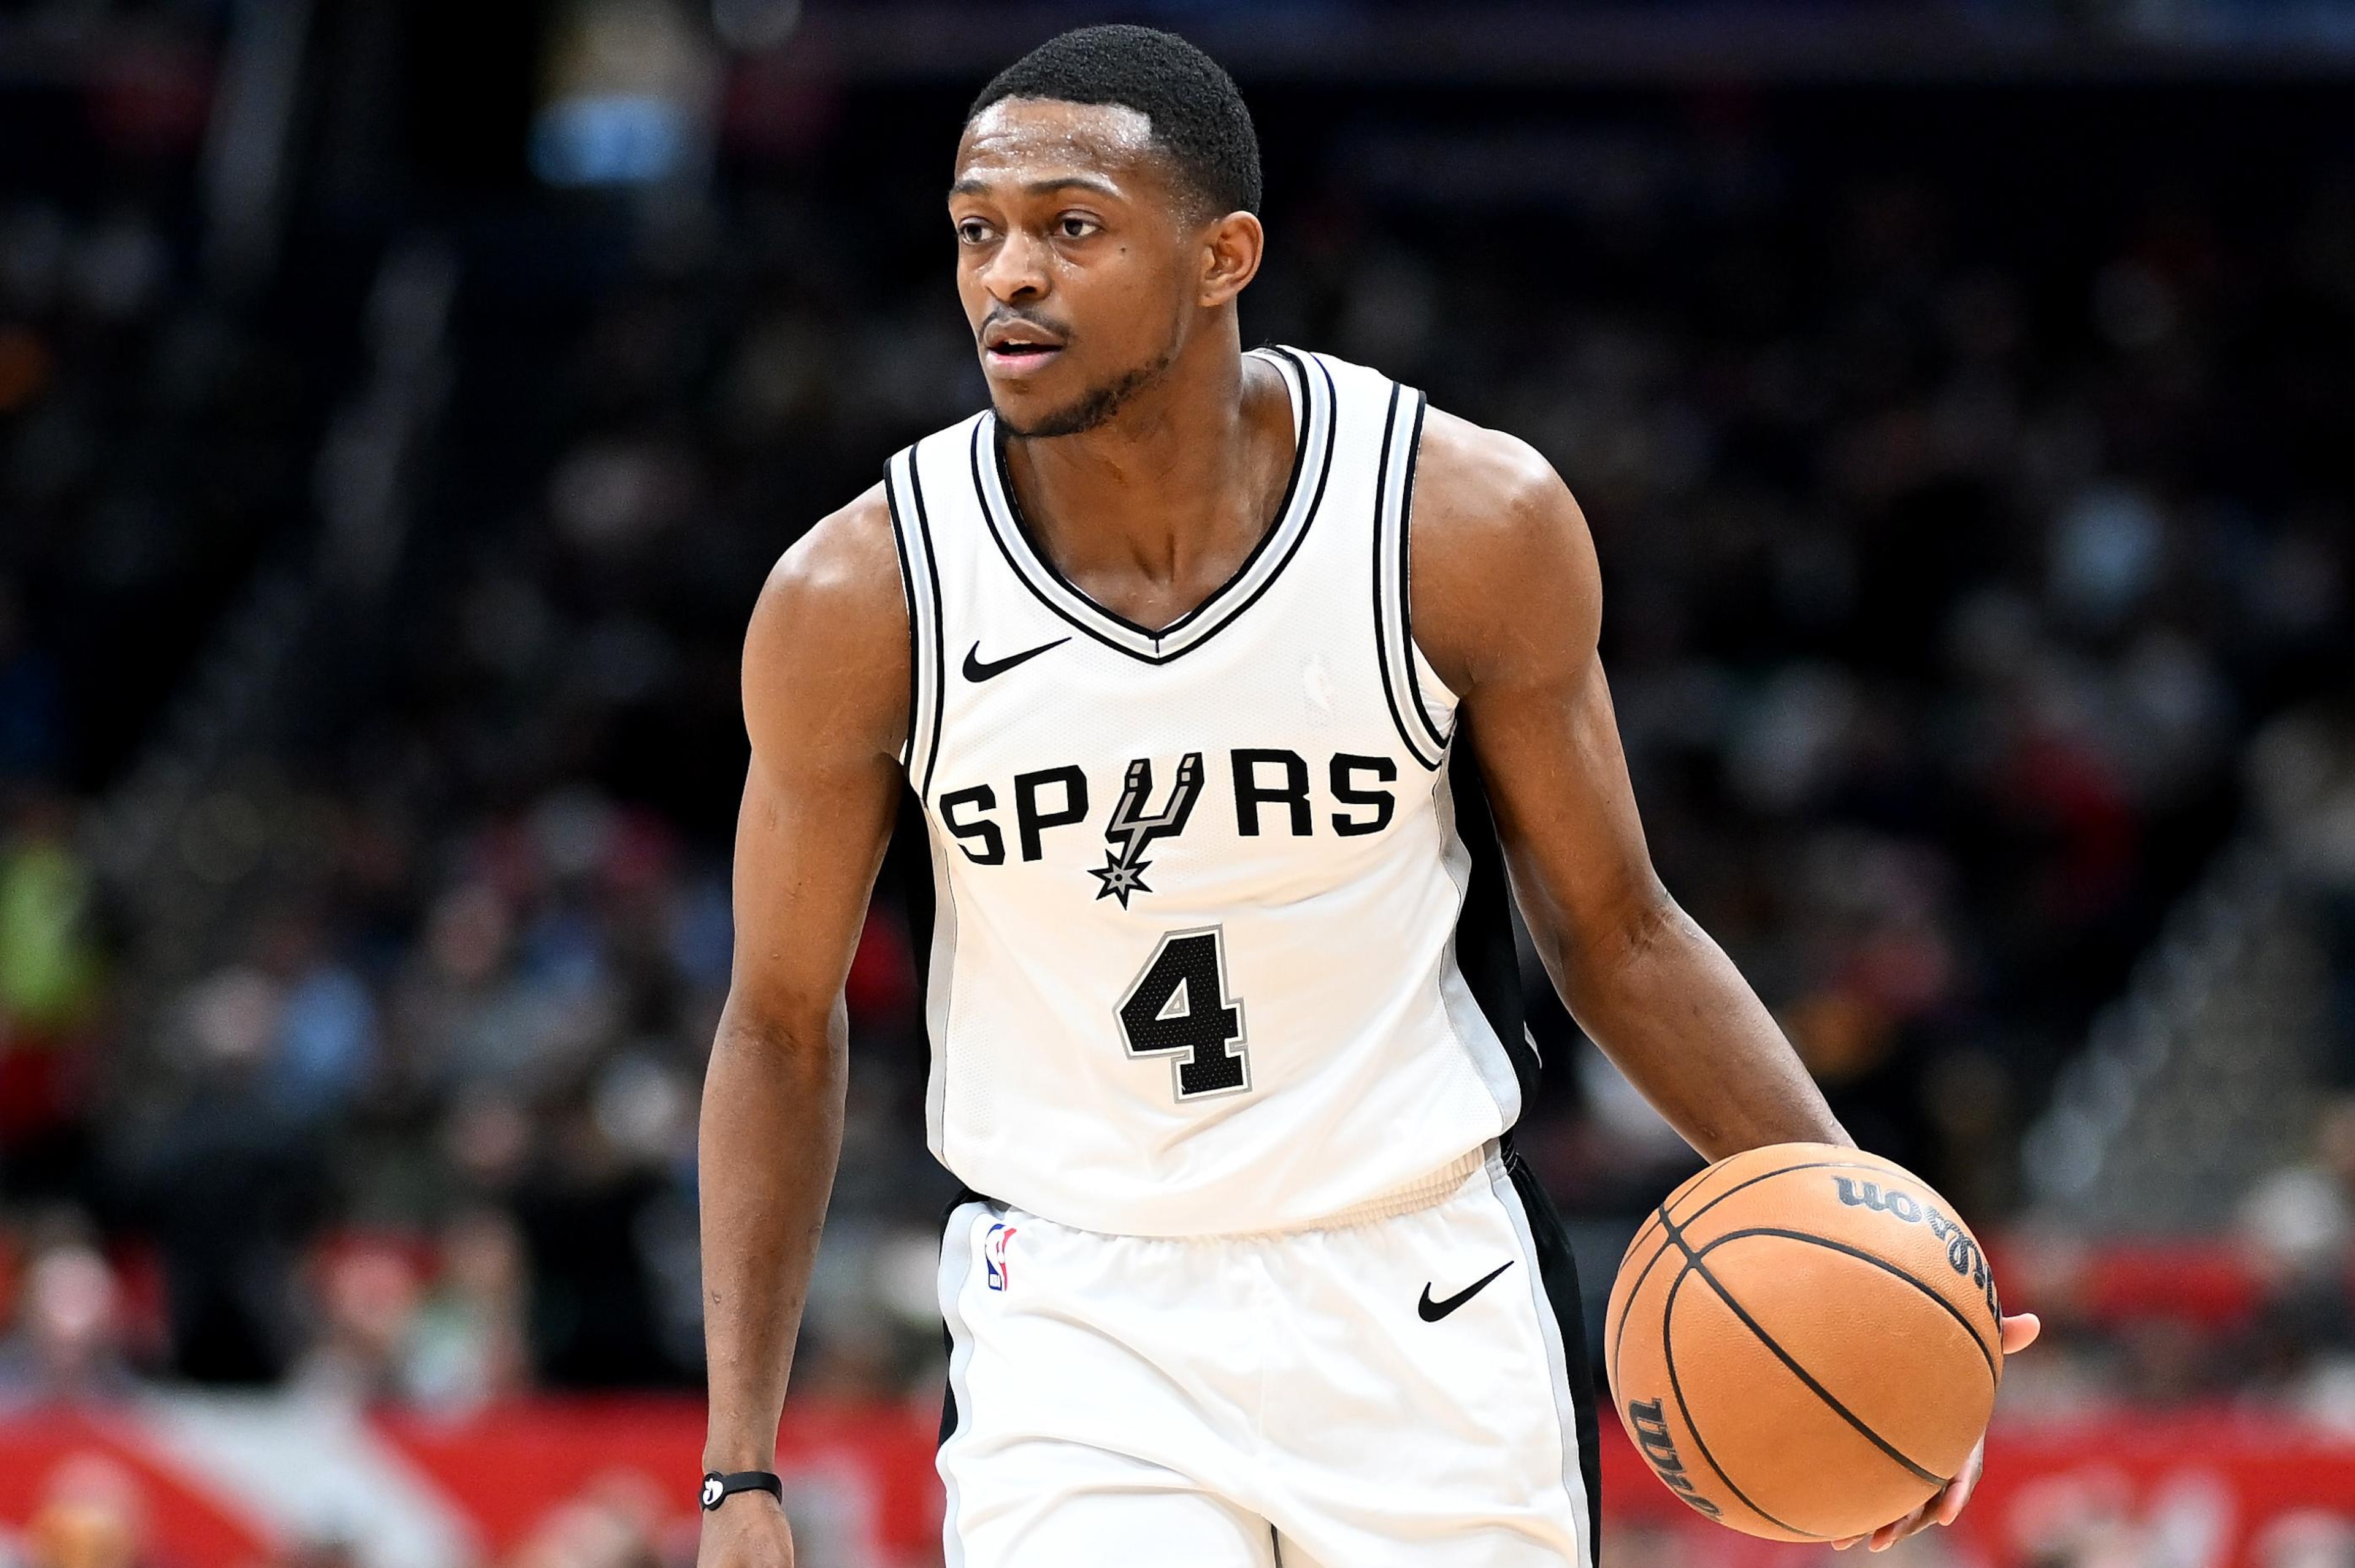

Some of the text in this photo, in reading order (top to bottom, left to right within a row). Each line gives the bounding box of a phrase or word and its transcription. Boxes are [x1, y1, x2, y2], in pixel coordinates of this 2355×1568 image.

[939, 748, 1398, 911] SPURS
[1111, 923, 1253, 1104] 4
[1629, 1398, 1723, 1521] Wil
